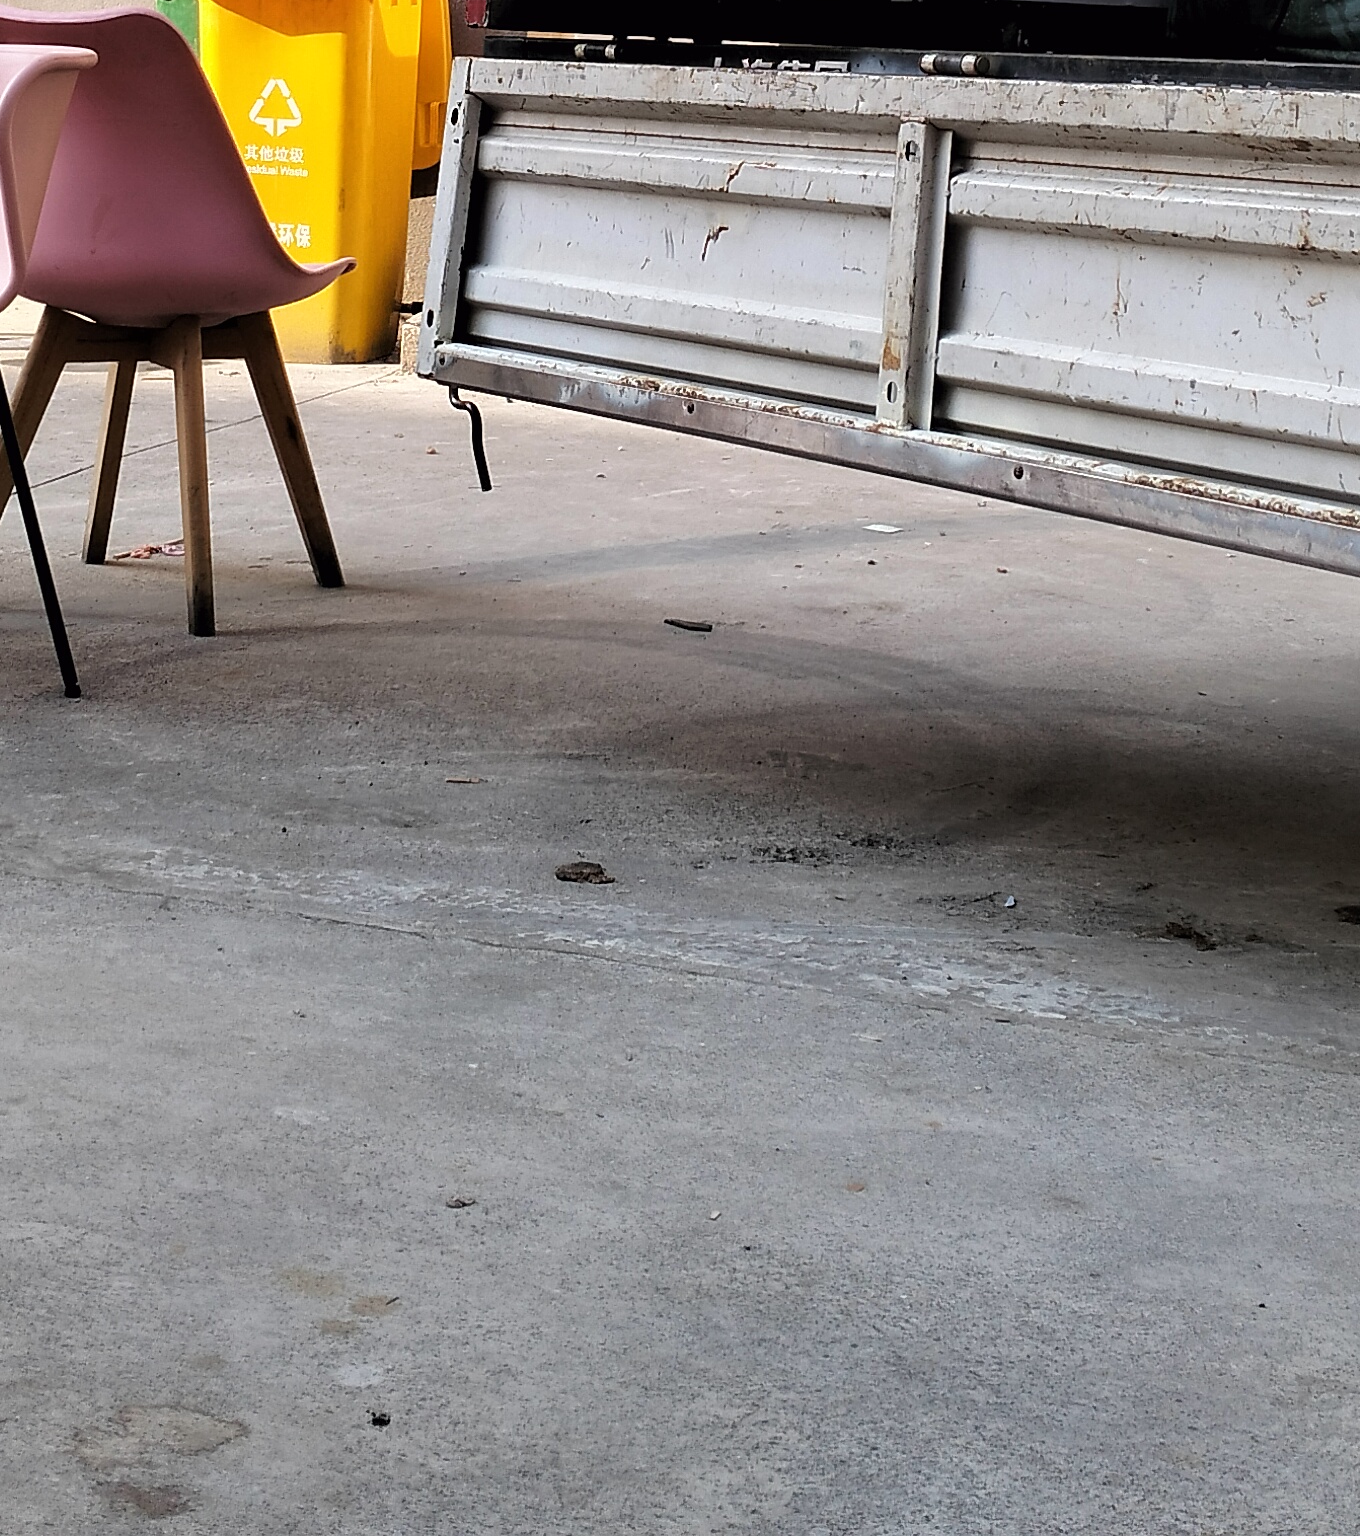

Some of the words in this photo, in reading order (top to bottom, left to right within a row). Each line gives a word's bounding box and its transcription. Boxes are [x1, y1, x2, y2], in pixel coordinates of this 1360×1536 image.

[244, 144, 305, 164] 其他垃圾
[246, 164, 279, 175] esidual
[280, 165, 309, 177] Waste
